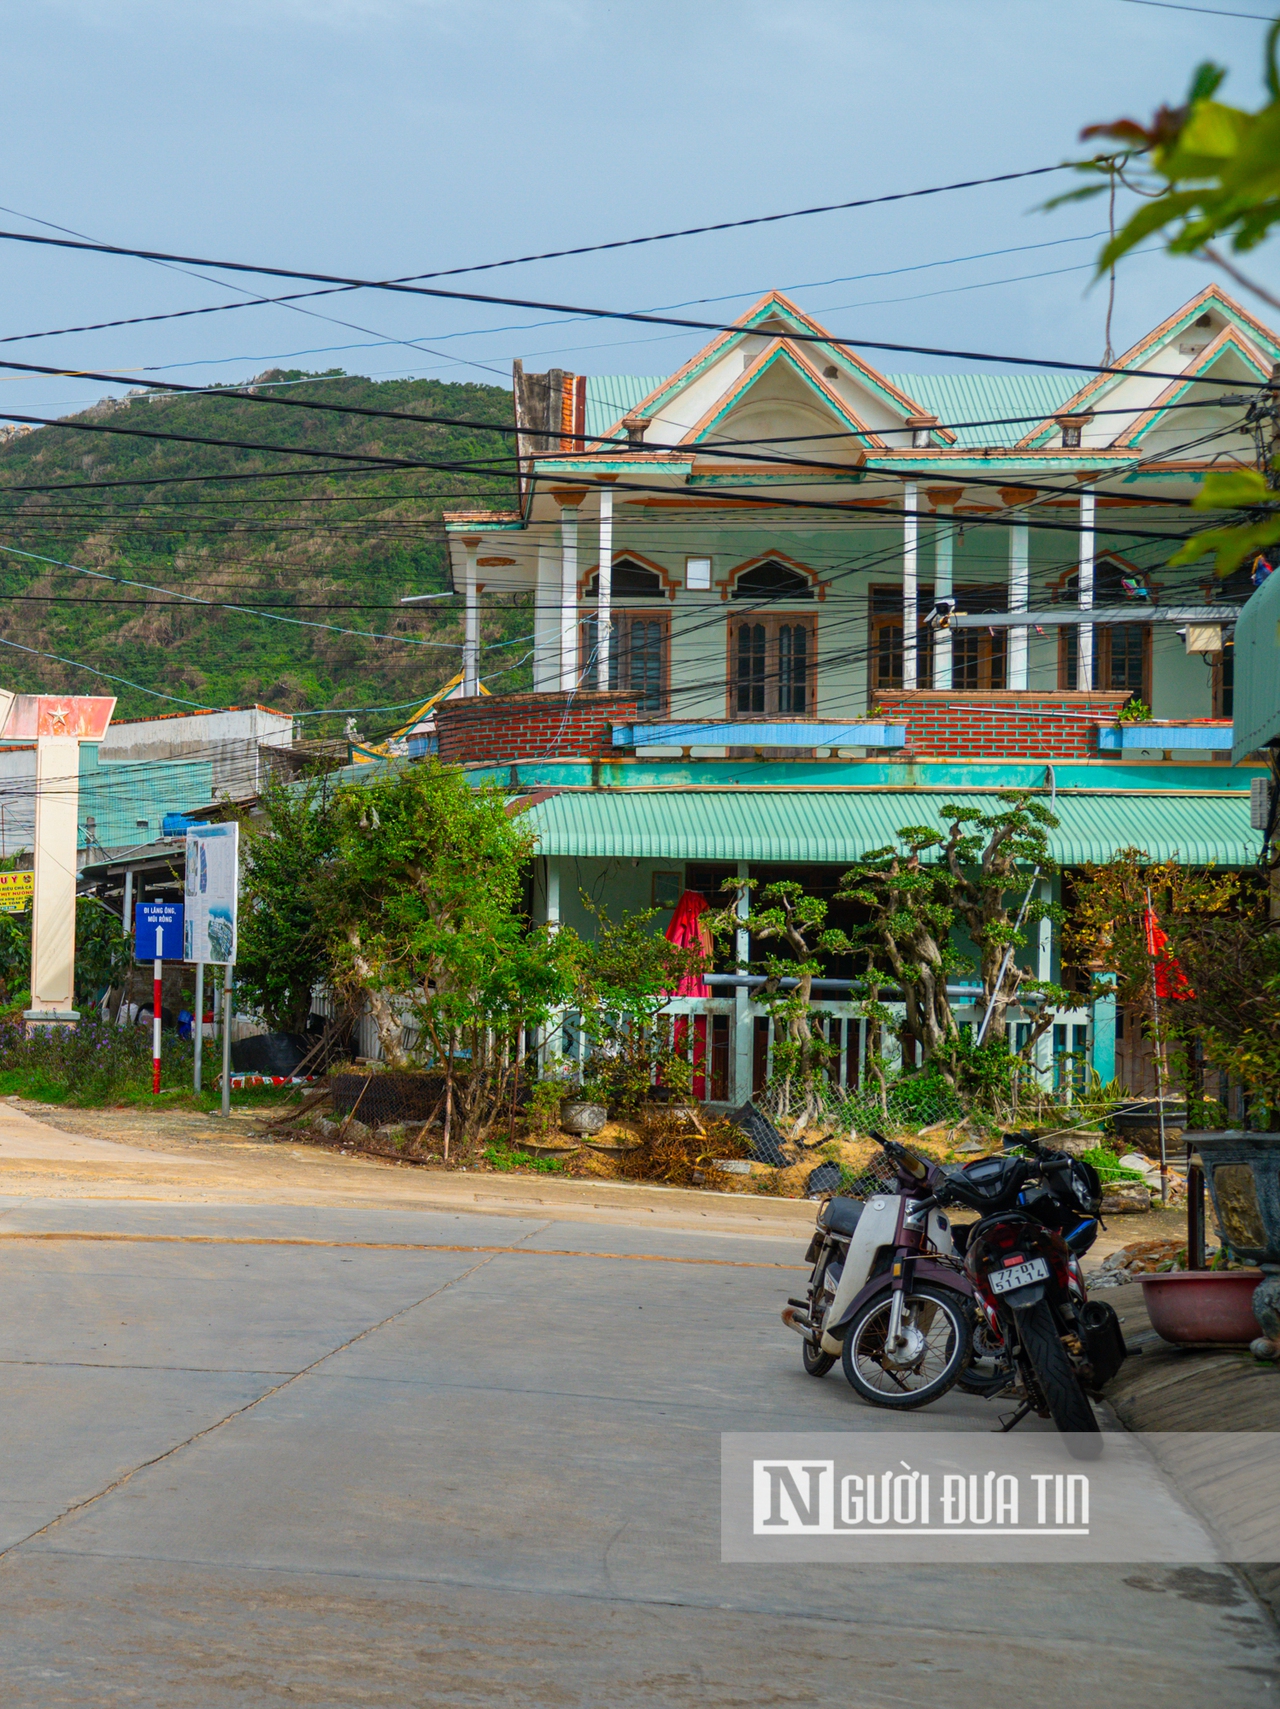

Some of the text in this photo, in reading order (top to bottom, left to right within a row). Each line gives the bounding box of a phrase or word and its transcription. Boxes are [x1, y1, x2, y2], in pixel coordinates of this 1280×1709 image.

[143, 906, 149, 914] ĐI
[995, 1269, 1045, 1291] 511.14
[998, 1262, 1035, 1281] 77-D1
